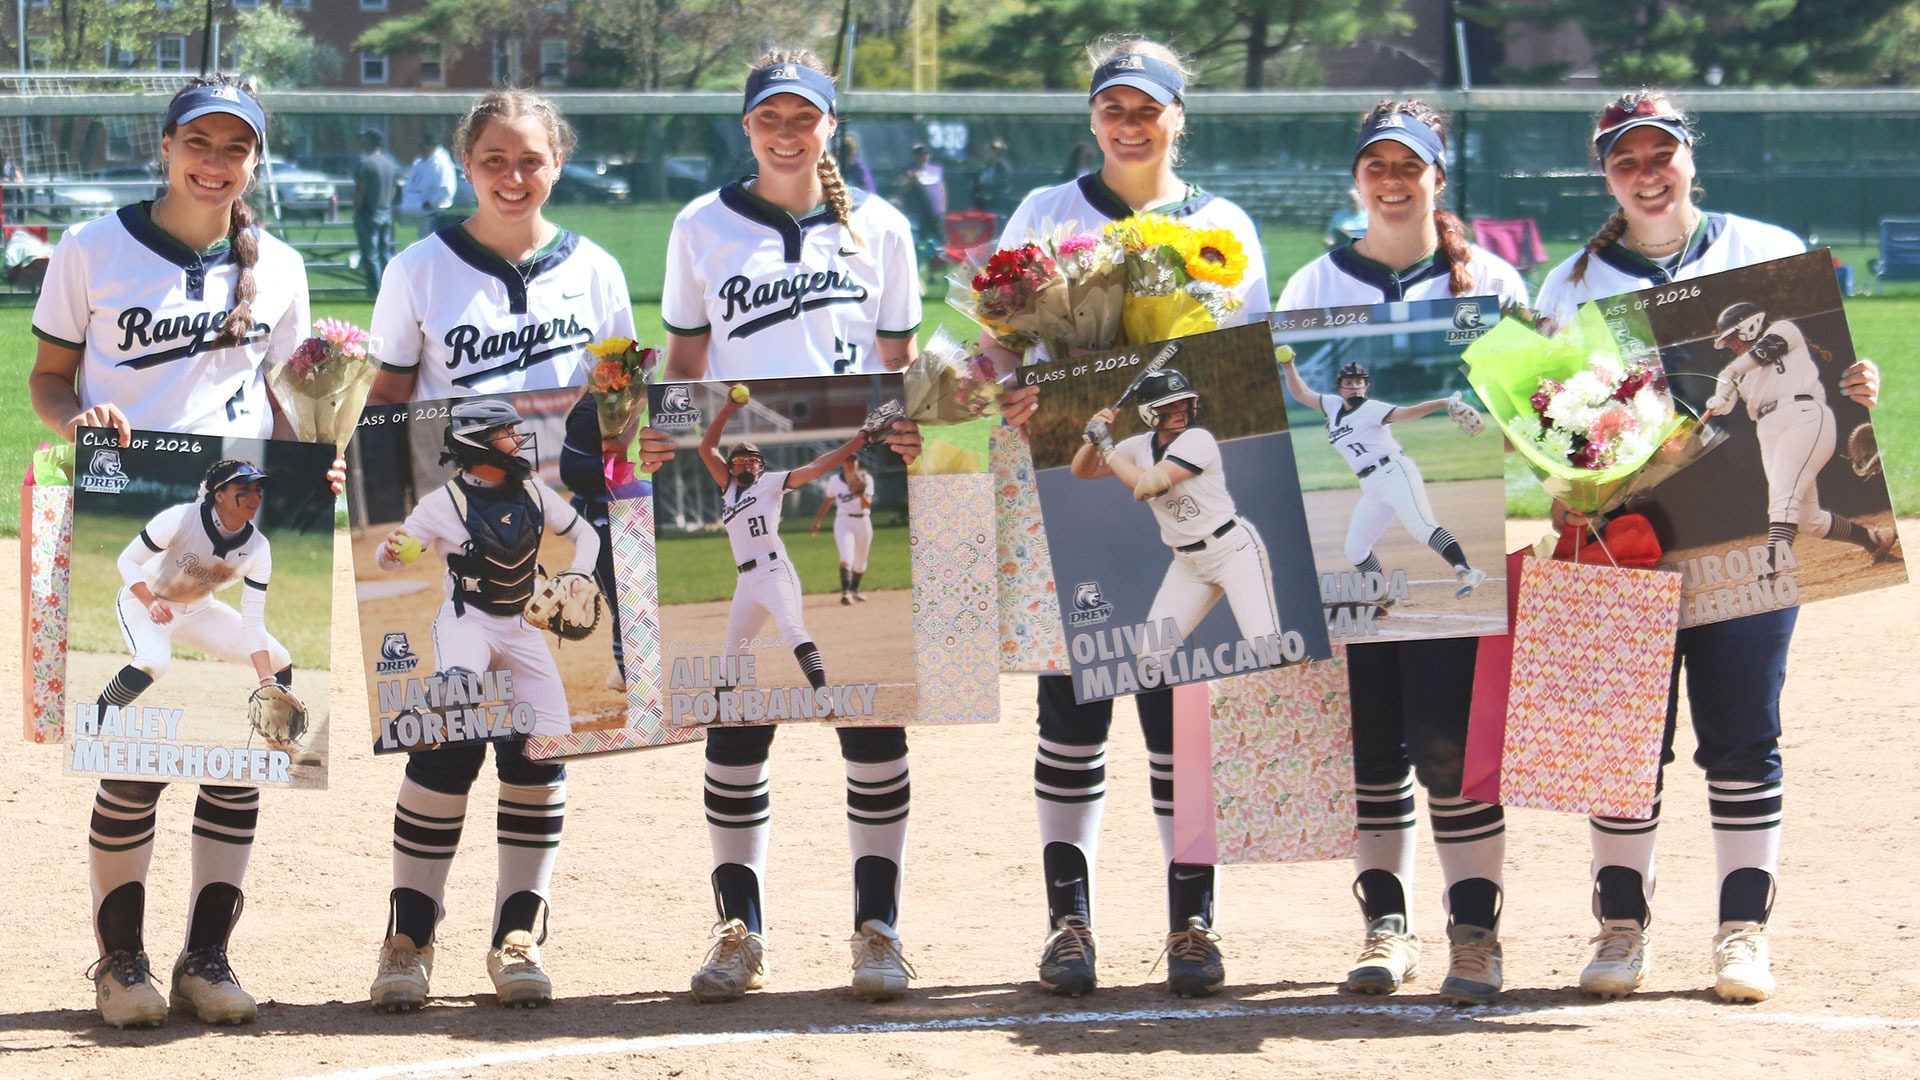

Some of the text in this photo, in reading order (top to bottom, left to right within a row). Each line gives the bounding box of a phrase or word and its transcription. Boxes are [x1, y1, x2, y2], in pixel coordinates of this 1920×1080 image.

[718, 269, 863, 323] Rangers
[1602, 285, 1702, 318] ASS OF 2026
[116, 306, 258, 360] Range
[1263, 312, 1368, 331] LASS OF 2026
[444, 314, 588, 374] Rangers
[1072, 365, 1088, 377] OF
[1094, 353, 1140, 373] 2026
[392, 413, 409, 424] OF
[415, 406, 461, 421] 2026
[656, 412, 700, 424] DREW
[132, 440, 149, 450] OF
[155, 438, 202, 453] 2026
[1346, 442, 1369, 458] 11
[83, 476, 128, 489] DREW
[1165, 494, 1200, 523] 23
[747, 515, 769, 538] 21
[1659, 539, 1798, 591] URORA
[1320, 568, 1410, 604] ANDA
[1070, 606, 1112, 624] DREW
[739, 636, 785, 650] 2026
[1071, 616, 1185, 665] OLIVIA
[376, 658, 420, 672] DREW
[669, 654, 757, 689] ALLIE
[1081, 630, 1306, 700] MAGLIACANO
[377, 669, 516, 713] NATALIE
[670, 683, 879, 725] PORBANSKY
[76, 703, 184, 740] HALEY
[379, 702, 537, 749] LORENZO
[72, 739, 292, 783] MEIERHOFER
